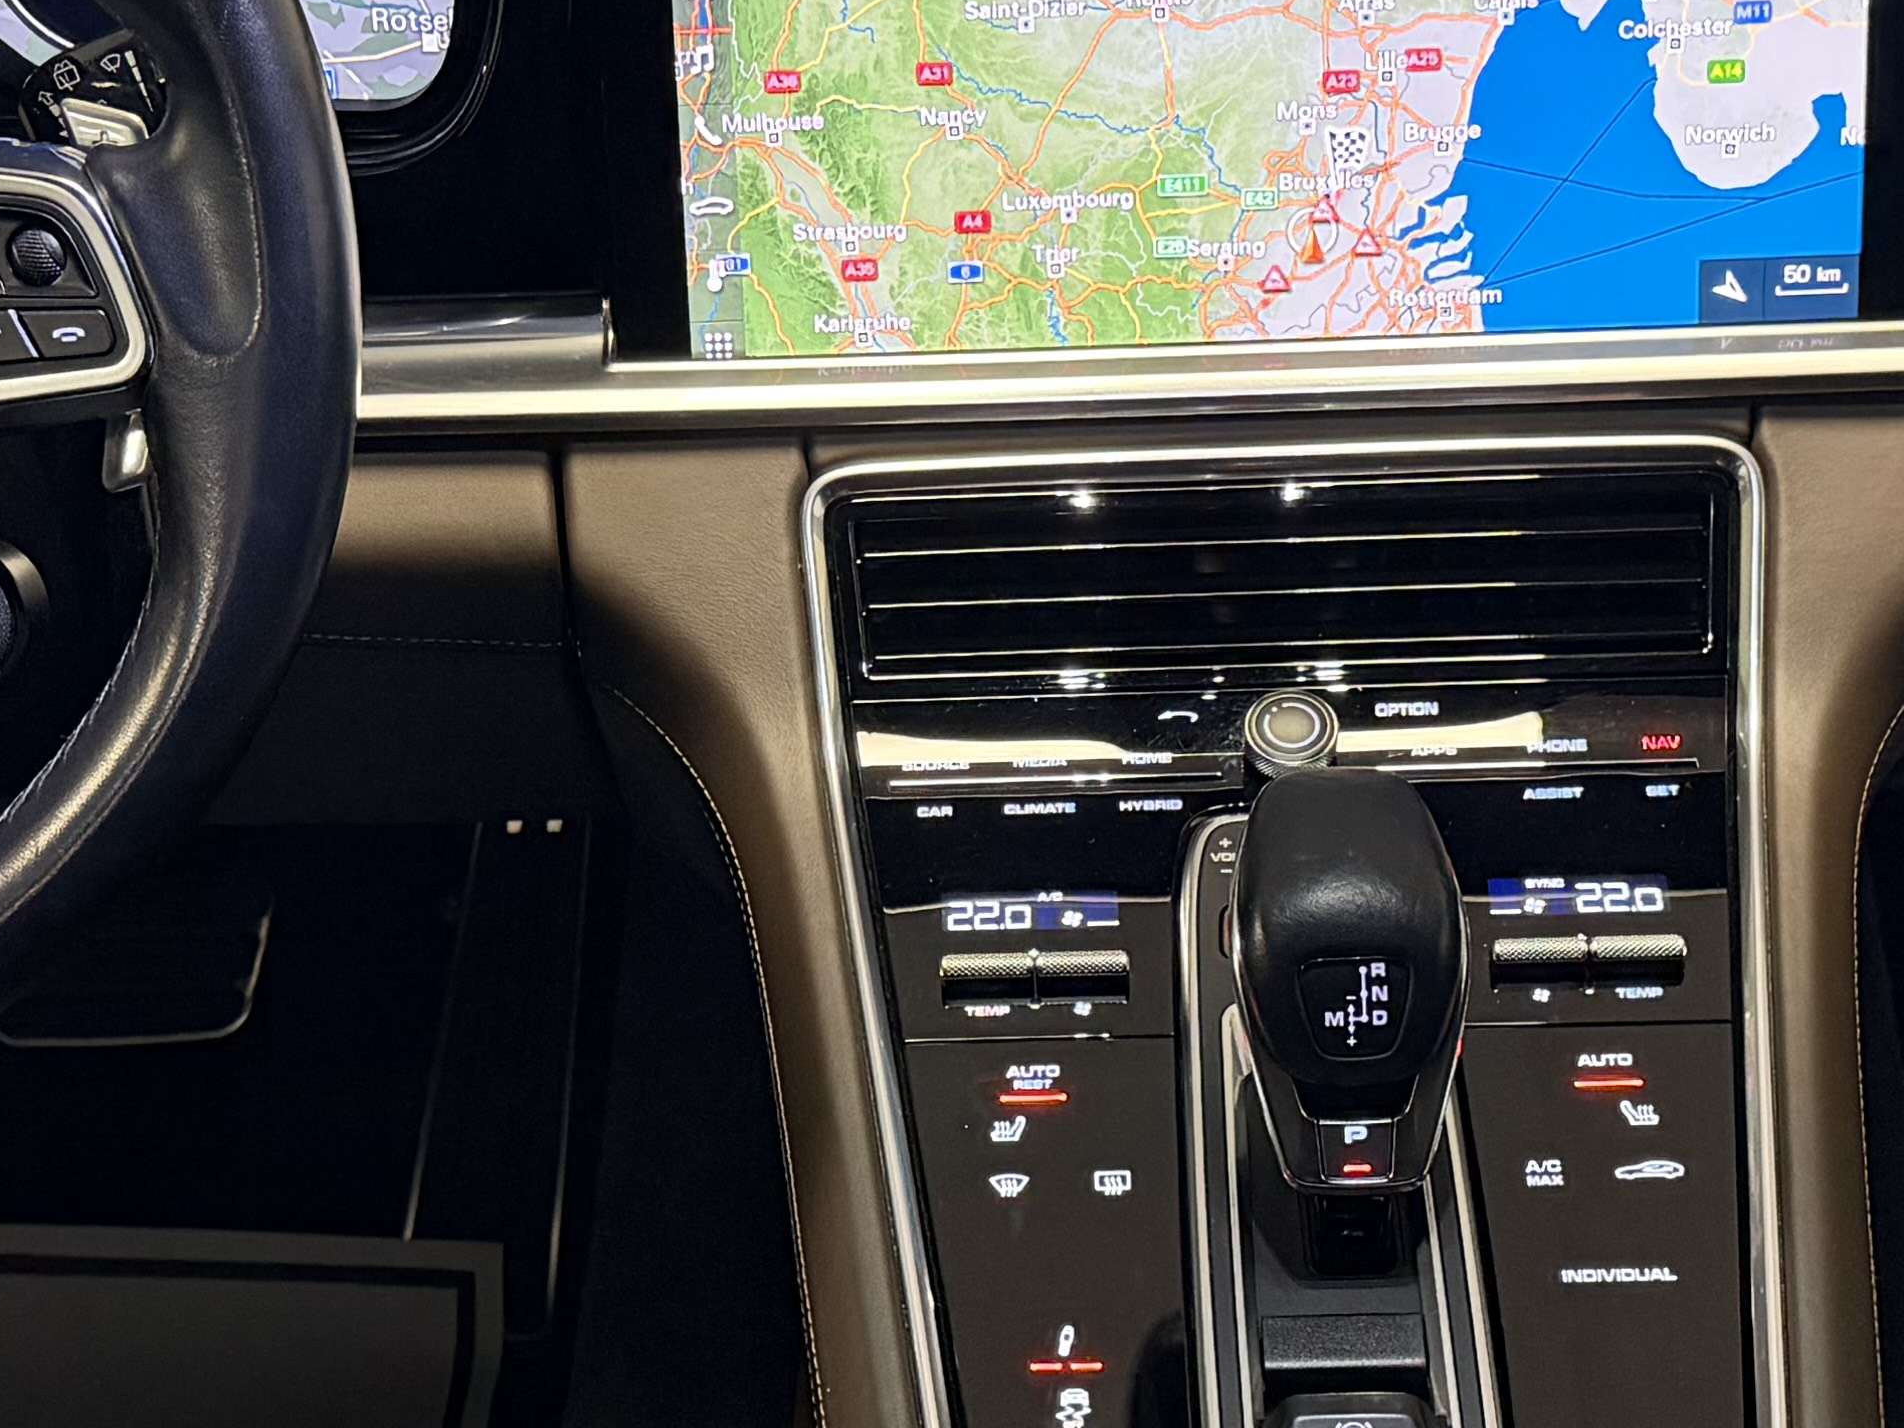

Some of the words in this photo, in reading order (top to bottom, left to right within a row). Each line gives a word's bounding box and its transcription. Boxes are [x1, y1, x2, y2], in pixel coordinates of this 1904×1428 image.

[1736, 2, 1770, 18] M11
[1617, 18, 1734, 40] Colchester
[1364, 50, 1409, 71] Lille
[1710, 63, 1743, 79] A14
[919, 106, 988, 128] Nancy
[1276, 101, 1338, 121] Mons
[722, 113, 824, 134] Mulhouse
[1403, 122, 1482, 143] Brugge
[1684, 122, 1776, 145] Norwich
[1278, 172, 1376, 193] Bruxelles
[1001, 189, 1136, 212] Luxembourg
[1245, 191, 1274, 205] E42
[962, 216, 985, 229] A4
[792, 223, 908, 243] Strasbourg
[1815, 266, 1842, 283] km
[1386, 287, 1503, 308] Rotterdam
[814, 315, 912, 333] Karlsruhe
[1374, 701, 1440, 717] OPTION
[1526, 738, 1589, 754] PHONE
[1640, 735, 1682, 752] NAV
[1121, 751, 1173, 765] HOME
[1522, 785, 1585, 800] ASSIST
[916, 805, 954, 818] CAR
[1003, 801, 1077, 815] CLIMATE
[1118, 798, 1184, 813] HYBRID
[1574, 881, 1665, 914] 22.0
[946, 901, 1032, 932] 22.0
[1370, 963, 1387, 978] R
[1371, 985, 1389, 1002] N
[1614, 986, 1664, 1000] TEMP
[963, 1004, 1011, 1018] TEMP
[1324, 1010, 1345, 1027] M
[1372, 1010, 1388, 1026] D
[1576, 1052, 1634, 1068] AUTO
[1005, 1064, 1061, 1079] AUTO
[1012, 1078, 1053, 1091] REST
[1343, 1125, 1369, 1145] P
[1525, 1158, 1562, 1174] A/C
[1526, 1174, 1565, 1188] MAX
[1560, 1267, 1678, 1284] INDIVIDUAL
